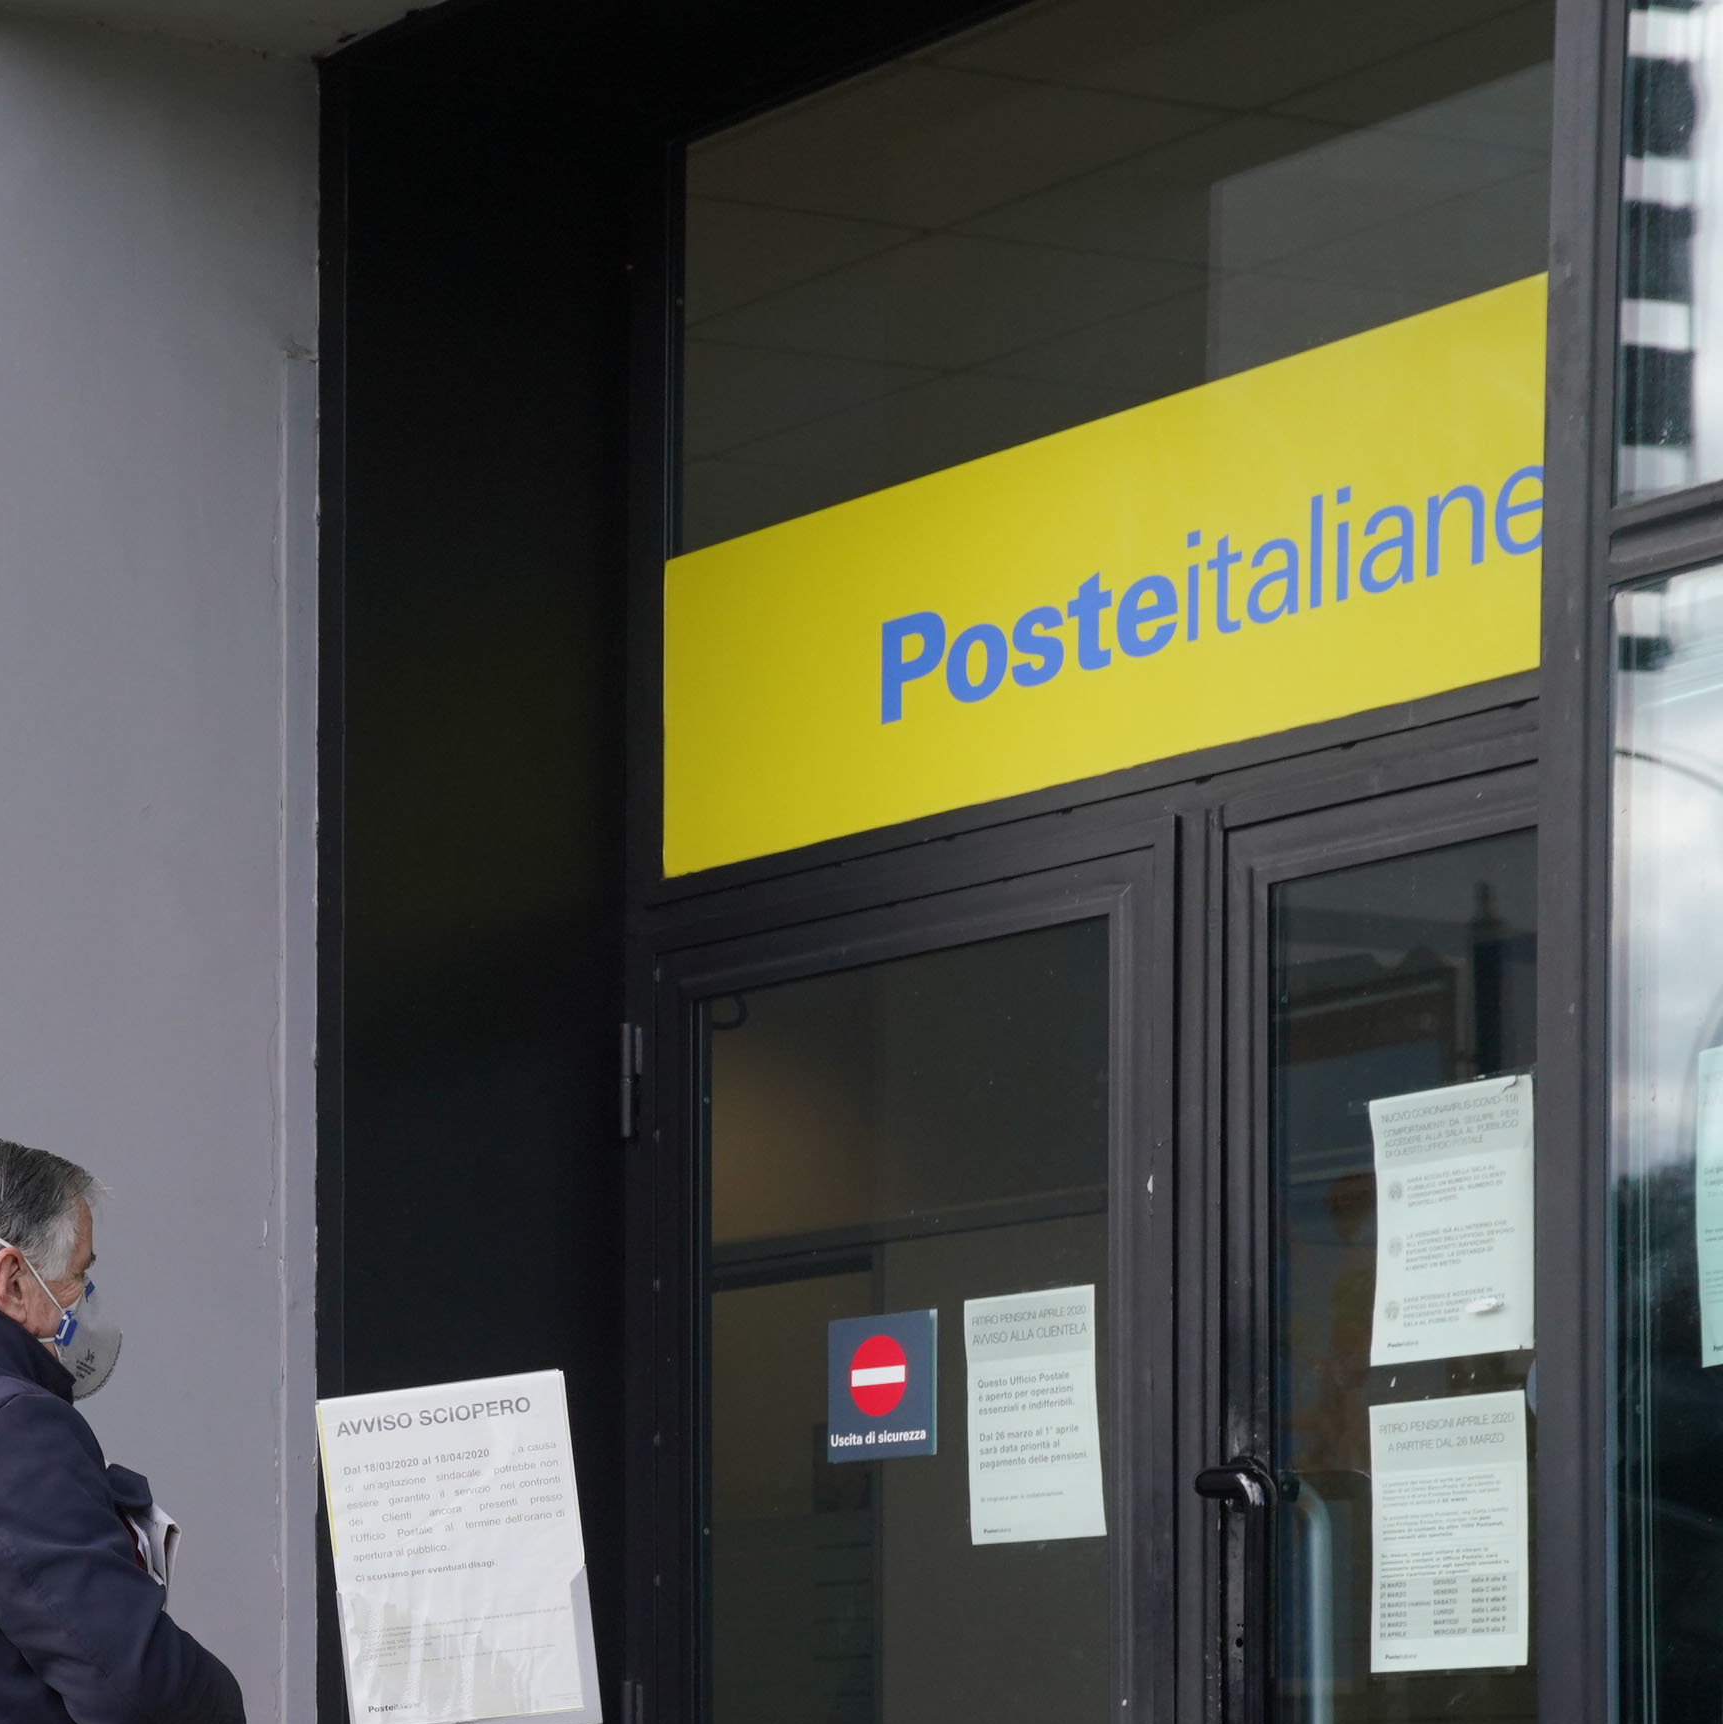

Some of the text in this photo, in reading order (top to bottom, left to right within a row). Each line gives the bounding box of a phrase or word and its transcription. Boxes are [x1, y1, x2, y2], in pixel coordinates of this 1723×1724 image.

[880, 464, 1545, 725] Posteitaliane
[1000, 1310, 1036, 1324] PENSIONI
[1039, 1306, 1065, 1318] APRILE
[1067, 1304, 1086, 1317] 2020
[973, 1322, 1088, 1345] AVVISO ALLA CLIENTELA
[978, 1371, 1070, 1389] Questo Ufficio Postale
[985, 1391, 1013, 1403] aperto
[1015, 1390, 1028, 1400] per
[1030, 1384, 1074, 1398] operazioni
[337, 1396, 532, 1438] AVVISO SCIOPERO
[978, 1403, 1019, 1416] essenziali
[1029, 1398, 1076, 1410] indifferibili.
[1410, 1417, 1454, 1432] PENSIONI
[1456, 1413, 1489, 1427] APRILE
[1491, 1411, 1516, 1425] 2020
[831, 1428, 927, 1448] Uscita di sicurezza
[979, 1432, 994, 1443] Dal
[995, 1431, 1005, 1441] 26
[1007, 1429, 1034, 1440] marzo
[1035, 1426, 1043, 1436] al
[1056, 1423, 1080, 1436] aprile
[1396, 1439, 1434, 1451] PARTIRE
[1436, 1437, 1454, 1449] DAL
[1470, 1432, 1505, 1445] MARZO
[1000, 1444, 1019, 1454] data
[1021, 1440, 1051, 1452] priorità
[1053, 1439, 1060, 1449] al
[343, 1466, 362, 1477] Dal
[364, 1456, 419, 1474] 18/03/2020
[422, 1456, 432, 1468] al
[434, 1447, 490, 1466] 18/04/2020
[527, 1441, 557, 1453] causa
[979, 1457, 1026, 1471] pagamento
[1029, 1454, 1049, 1465] delle
[345, 1484, 354, 1494] di
[363, 1474, 427, 1493] un'agitazione
[493, 1460, 537, 1478] potrebbe
[540, 1457, 559, 1469] non
[346, 1498, 380, 1511] essere
[388, 1491, 431, 1508] garantito
[454, 1483, 492, 1498] servizio
[519, 1474, 562, 1489] confronti
[348, 1492, 563, 1528] dei Clienti ancora presenti presso
[351, 1507, 565, 1545] l'Ufficio Postale al termine dell'orario di
[352, 1541, 451, 1564] apertura al pubblico.
[355, 1573, 365, 1583] Ci
[366, 1567, 409, 1582] scusiamo
[411, 1564, 425, 1579] per
[427, 1558, 467, 1576] eventuali
